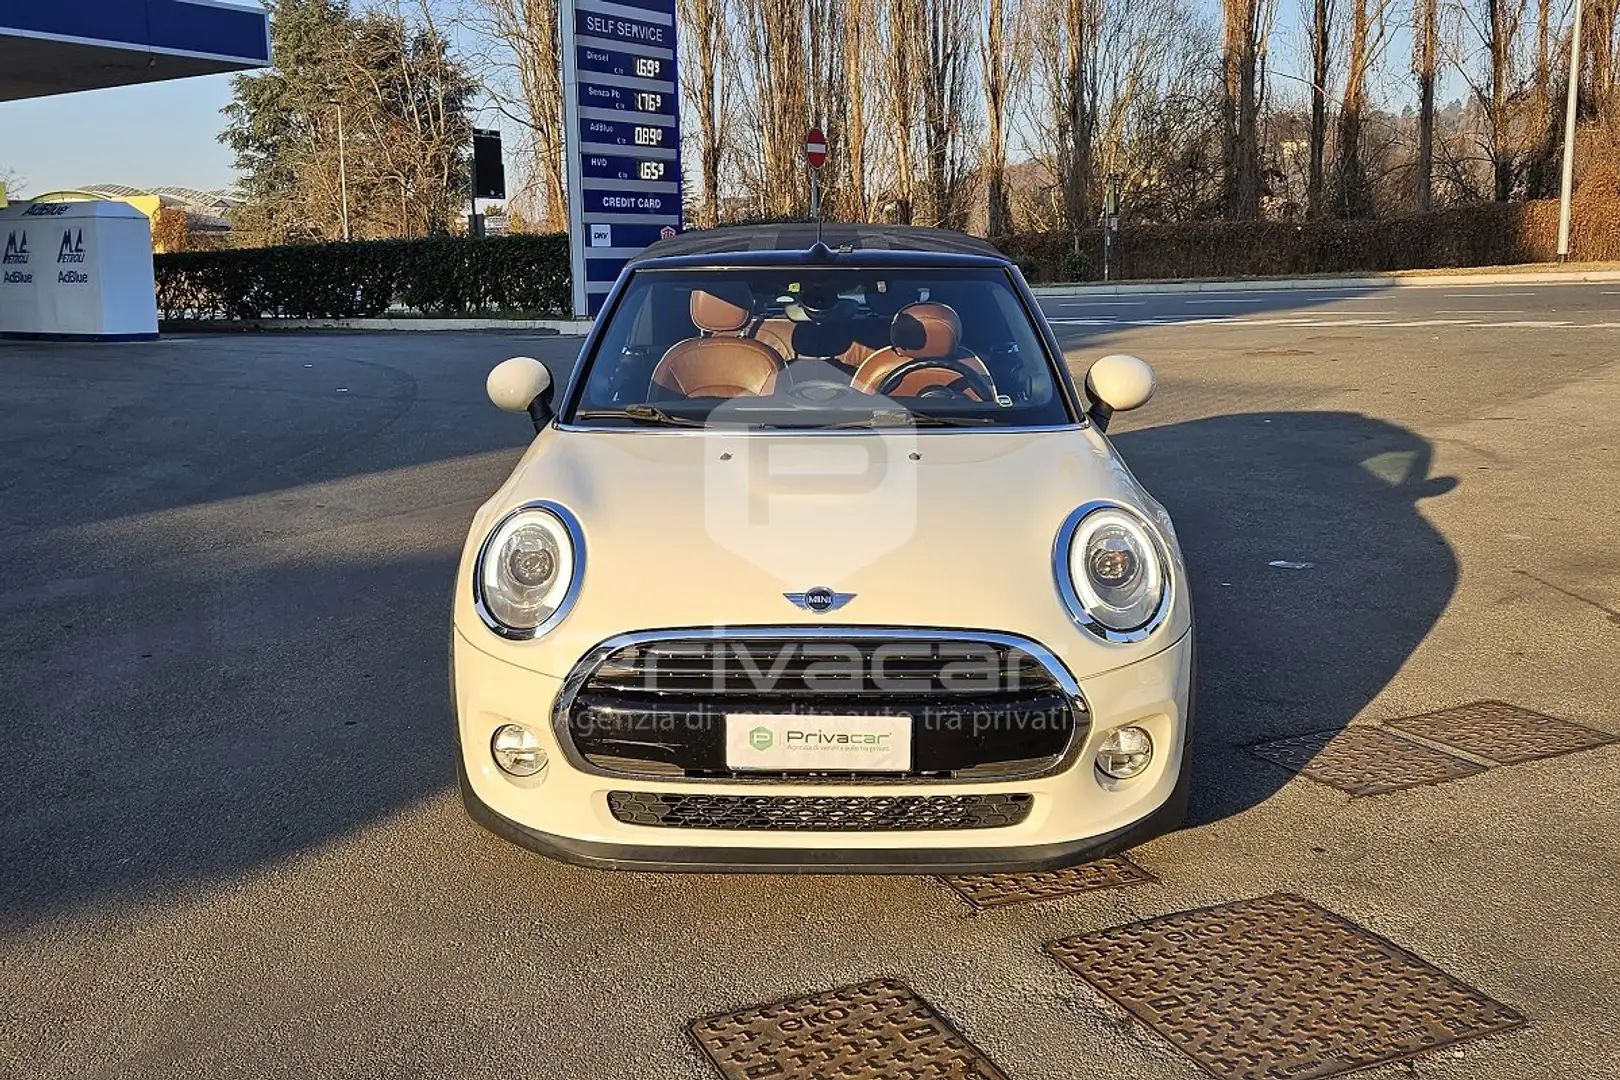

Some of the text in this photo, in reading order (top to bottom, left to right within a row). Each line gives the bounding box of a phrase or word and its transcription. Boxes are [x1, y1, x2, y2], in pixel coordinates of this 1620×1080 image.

[586, 16, 663, 42] SELF SERVICE
[586, 50, 609, 62] Diesel
[588, 86, 621, 99] Senza Pb
[590, 122, 614, 133] AdBlue
[591, 158, 607, 167] HVO
[602, 197, 662, 209] CREDIT CARD
[3, 270, 33, 284] AdBlue
[58, 270, 88, 284] AdBlue
[808, 595, 832, 604] MINI
[787, 729, 890, 744] Privacar
